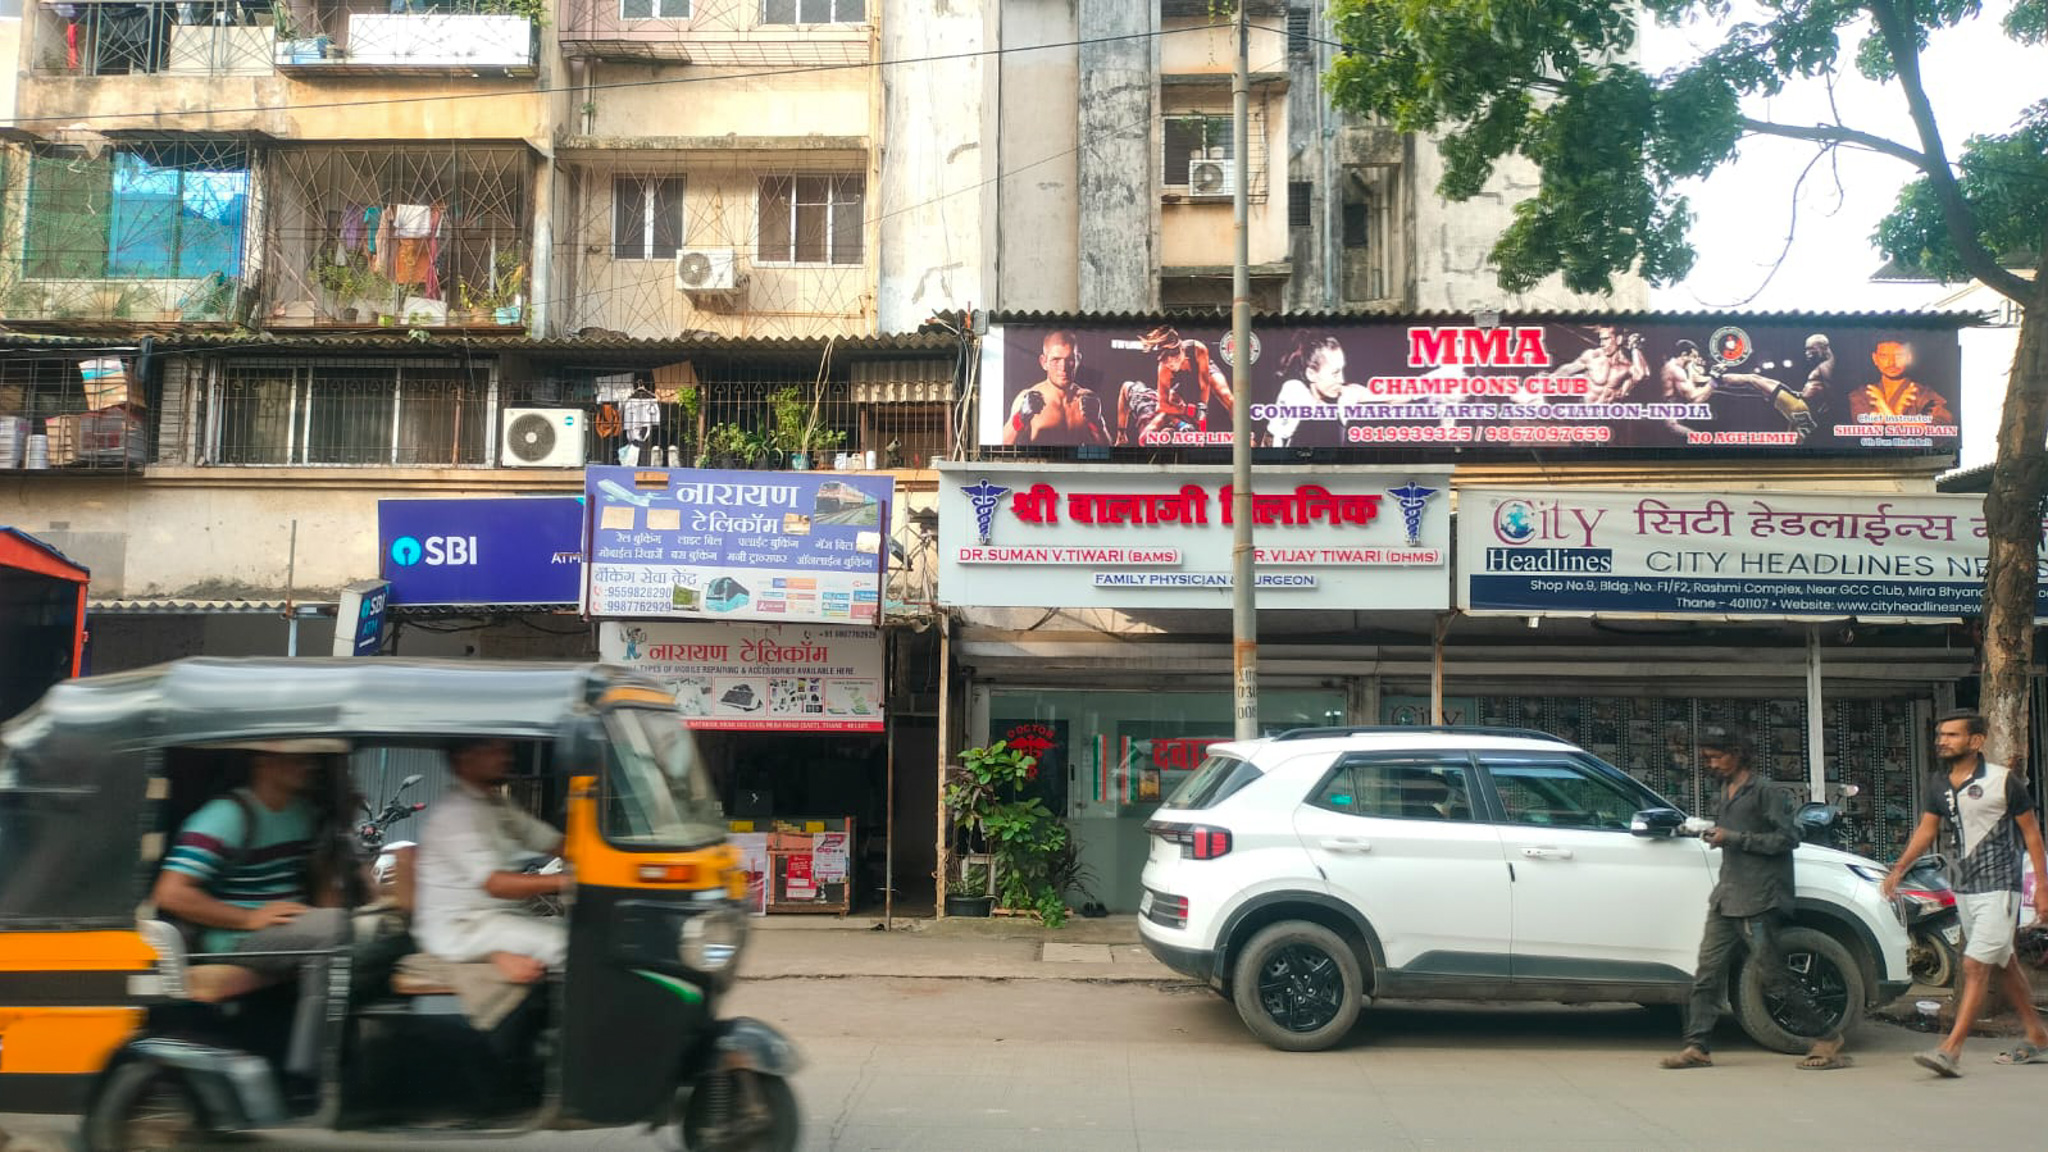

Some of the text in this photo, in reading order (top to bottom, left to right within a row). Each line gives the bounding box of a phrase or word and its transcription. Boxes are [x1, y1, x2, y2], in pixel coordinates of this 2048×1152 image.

[1409, 328, 1550, 367] MMA
[1369, 376, 1590, 395] CHAMPIONS CLUB
[1250, 403, 1339, 420] COMBAT
[1344, 403, 1438, 420] MARTIAL
[1442, 403, 1496, 420] ARTS
[1146, 432, 1170, 444] NO
[1172, 432, 1205, 444] AGE
[1348, 426, 1472, 441] 9819939325
[1485, 426, 1611, 442] 9867097659
[1688, 432, 1798, 445] NO AGE LIMIT
[676, 482, 801, 508] नारायण
[1010, 483, 1059, 524] श्री
[1068, 484, 1209, 525] बालाजी
[690, 509, 780, 534] टेलिकॉम
[1493, 498, 1608, 547] City
[1633, 499, 1734, 537] सिटी
[1748, 500, 1957, 547] हेडलाईन्स
[425, 536, 478, 565] SBI
[960, 548, 1178, 562] DR.SUMAN V.TIWARI (BAMS)
[1254, 550, 1438, 564] R.VIJAY TIWARI (DHMS)
[1489, 549, 1611, 572] Headlines
[1646, 551, 1727, 573] CITY
[1741, 553, 1934, 577] HEADLINES
[1095, 574, 1147, 585] FAMILY
[1150, 574, 1227, 586] PHYSICIAN
[1254, 575, 1314, 586] URGEON
[1530, 580, 1563, 592] Shop
[1566, 580, 1597, 592] No.9,
[1600, 580, 1632, 594] Bldg.
[1634, 581, 1653, 592] No.
[1694, 582, 1741, 593] Rashmi
[1744, 583, 1803, 597] Complex,
[1807, 584, 1836, 595] Near
[1840, 584, 1869, 596] GCC
[1873, 584, 1905, 598] Club,
[1908, 586, 1935, 598] Mira
[369, 594, 386, 616] SBI
[1676, 597, 1716, 609] Thane
[1730, 598, 1769, 610] 401107
[1780, 600, 1834, 611] Website:
[1837, 600, 1982, 614] www.cityheadlinesnew
[648, 637, 829, 663] नारायण टेलिकॉम
[1008, 725, 1054, 739] DOCTOR
